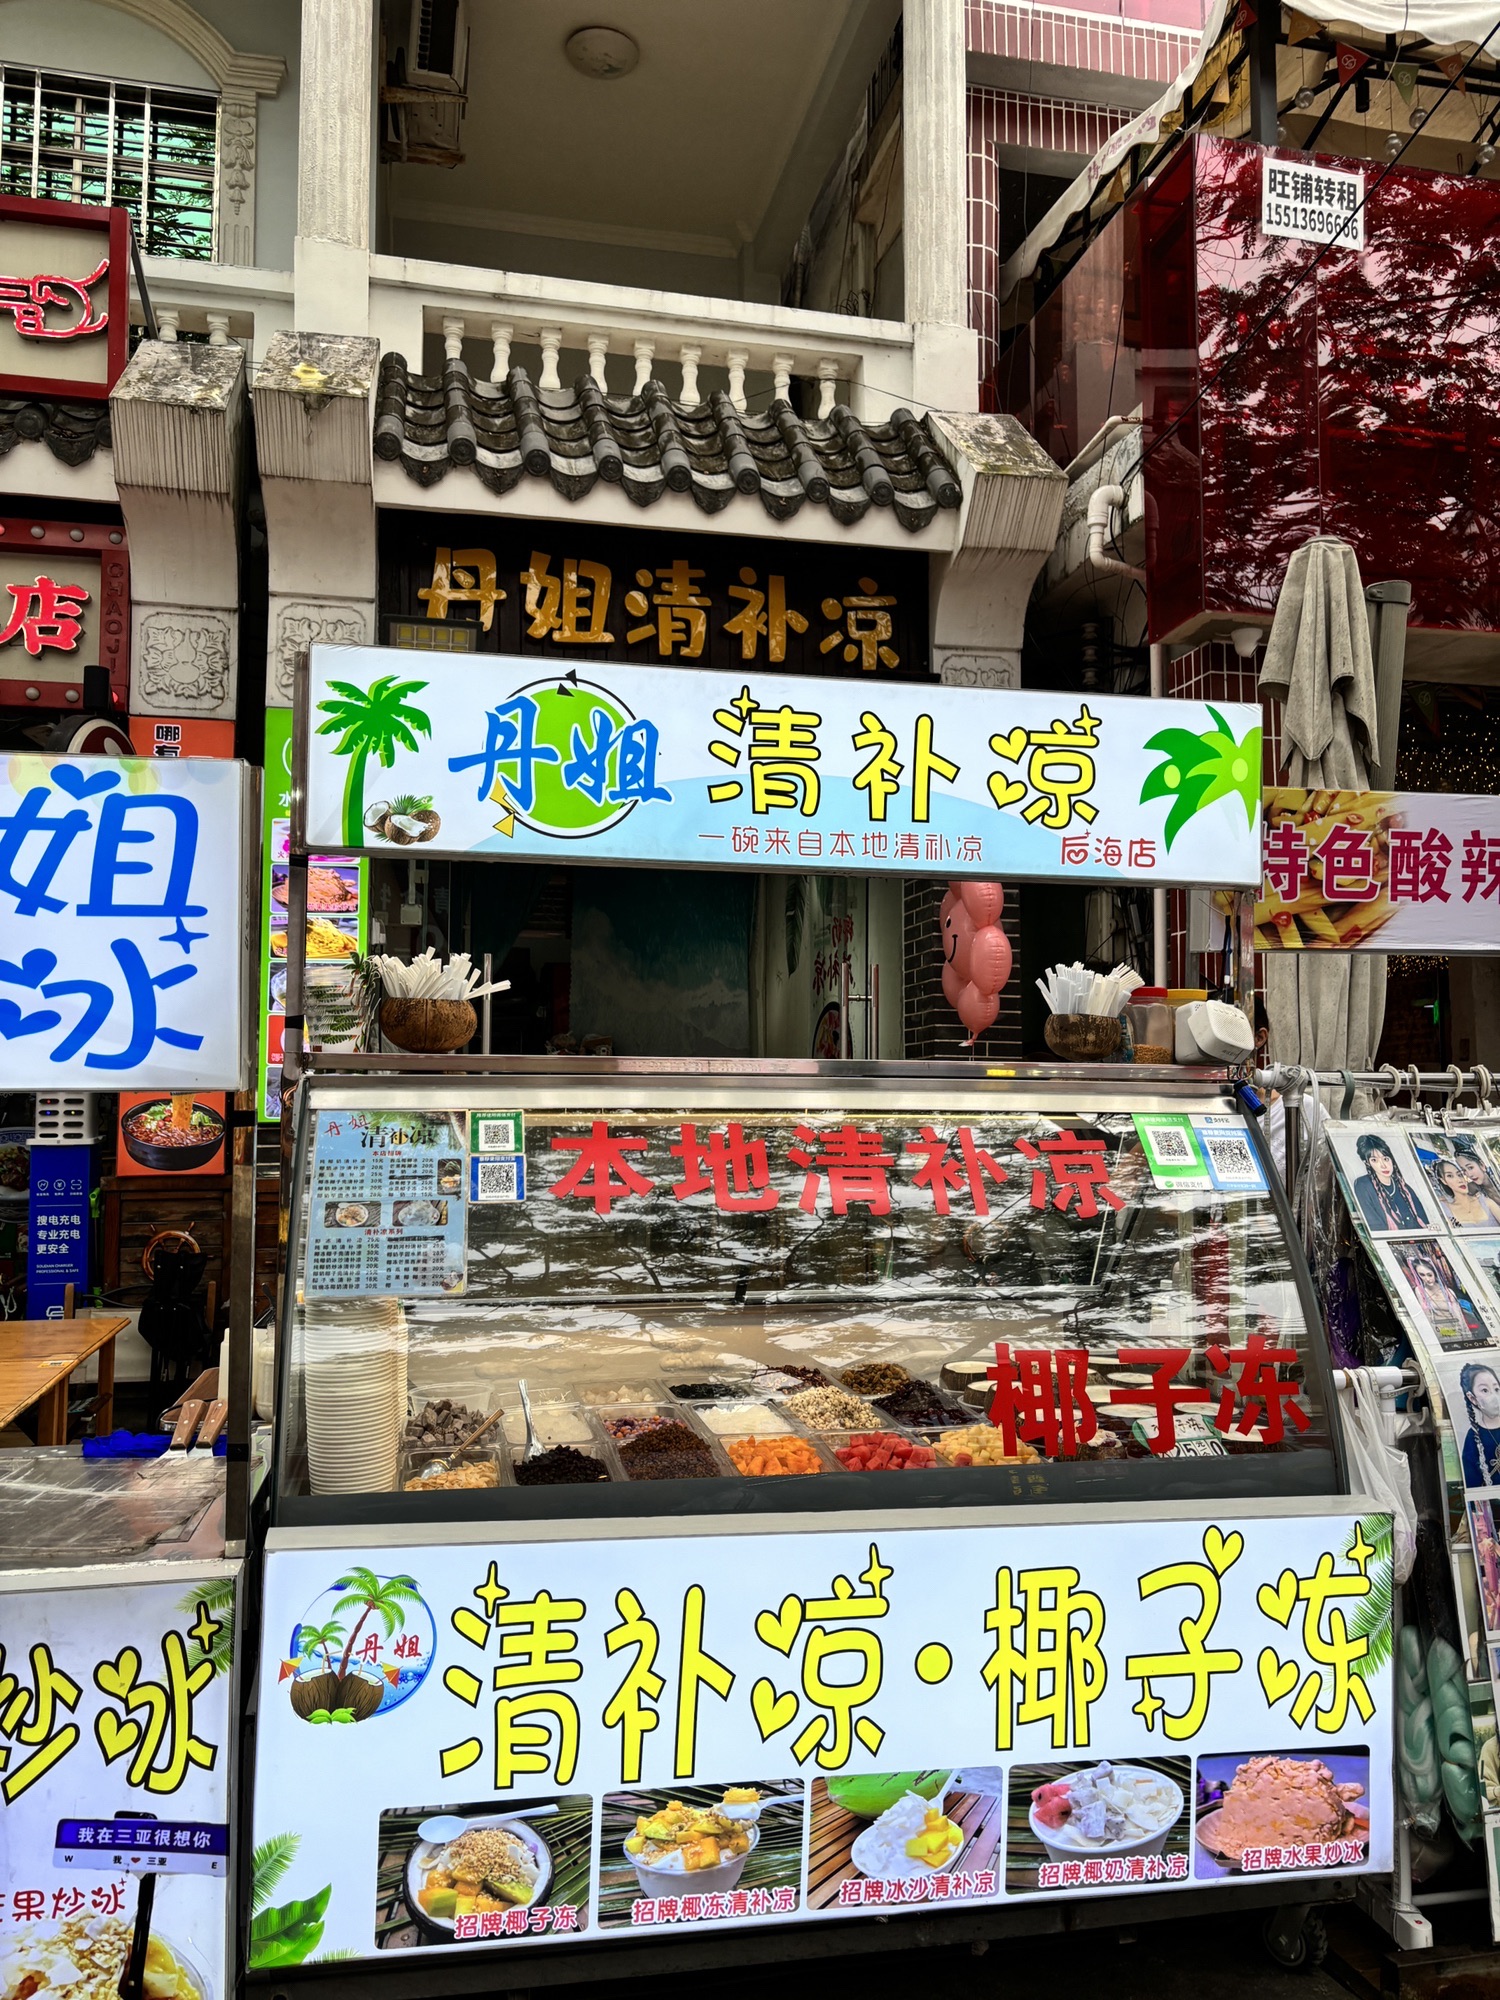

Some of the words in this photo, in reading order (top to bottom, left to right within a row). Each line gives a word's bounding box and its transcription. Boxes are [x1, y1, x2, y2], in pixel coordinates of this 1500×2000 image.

[1268, 168, 1358, 212] 旺铺转租
[1266, 202, 1359, 240] 15513696666
[0, 575, 90, 656] 店
[106, 562, 124, 674] CHAOJI
[417, 547, 900, 671] 丹姐清补凉
[448, 695, 671, 812] 丹姐
[707, 686, 1102, 829] 清补凉
[0, 764, 208, 917] 姐
[697, 825, 983, 863] 一碗来自本地清补凉
[1060, 829, 1157, 868] 后海店
[0, 937, 207, 1071] 冰
[324, 1114, 371, 1137] 丹姐
[361, 1123, 437, 1148] 清补凉
[549, 1121, 1126, 1219] 本地清补凉
[37, 1215, 81, 1226] 搜电充电
[37, 1229, 81, 1240] 专业充电
[36, 1243, 69, 1255] 更安全
[987, 1333, 1313, 1457] 椰子冻
[355, 1633, 422, 1664] 丹姐
[78, 1827, 212, 1849] 我在三亚很想你
[1243, 1841, 1364, 1870] 招牌水果炒冰
[64, 1855, 74, 1863] W
[113, 1855, 123, 1865] 我
[146, 1856, 168, 1866] 三亚
[211, 1861, 218, 1870] E
[1040, 1855, 1187, 1887] 招牌椰奶清补凉
[0, 1880, 126, 1922] 果炒冰
[840, 1871, 995, 1904] 招牌冰沙清补凉
[455, 1906, 577, 1938] 招牌椰子冻
[633, 1888, 795, 1923] 招牌椰冻清补凉
